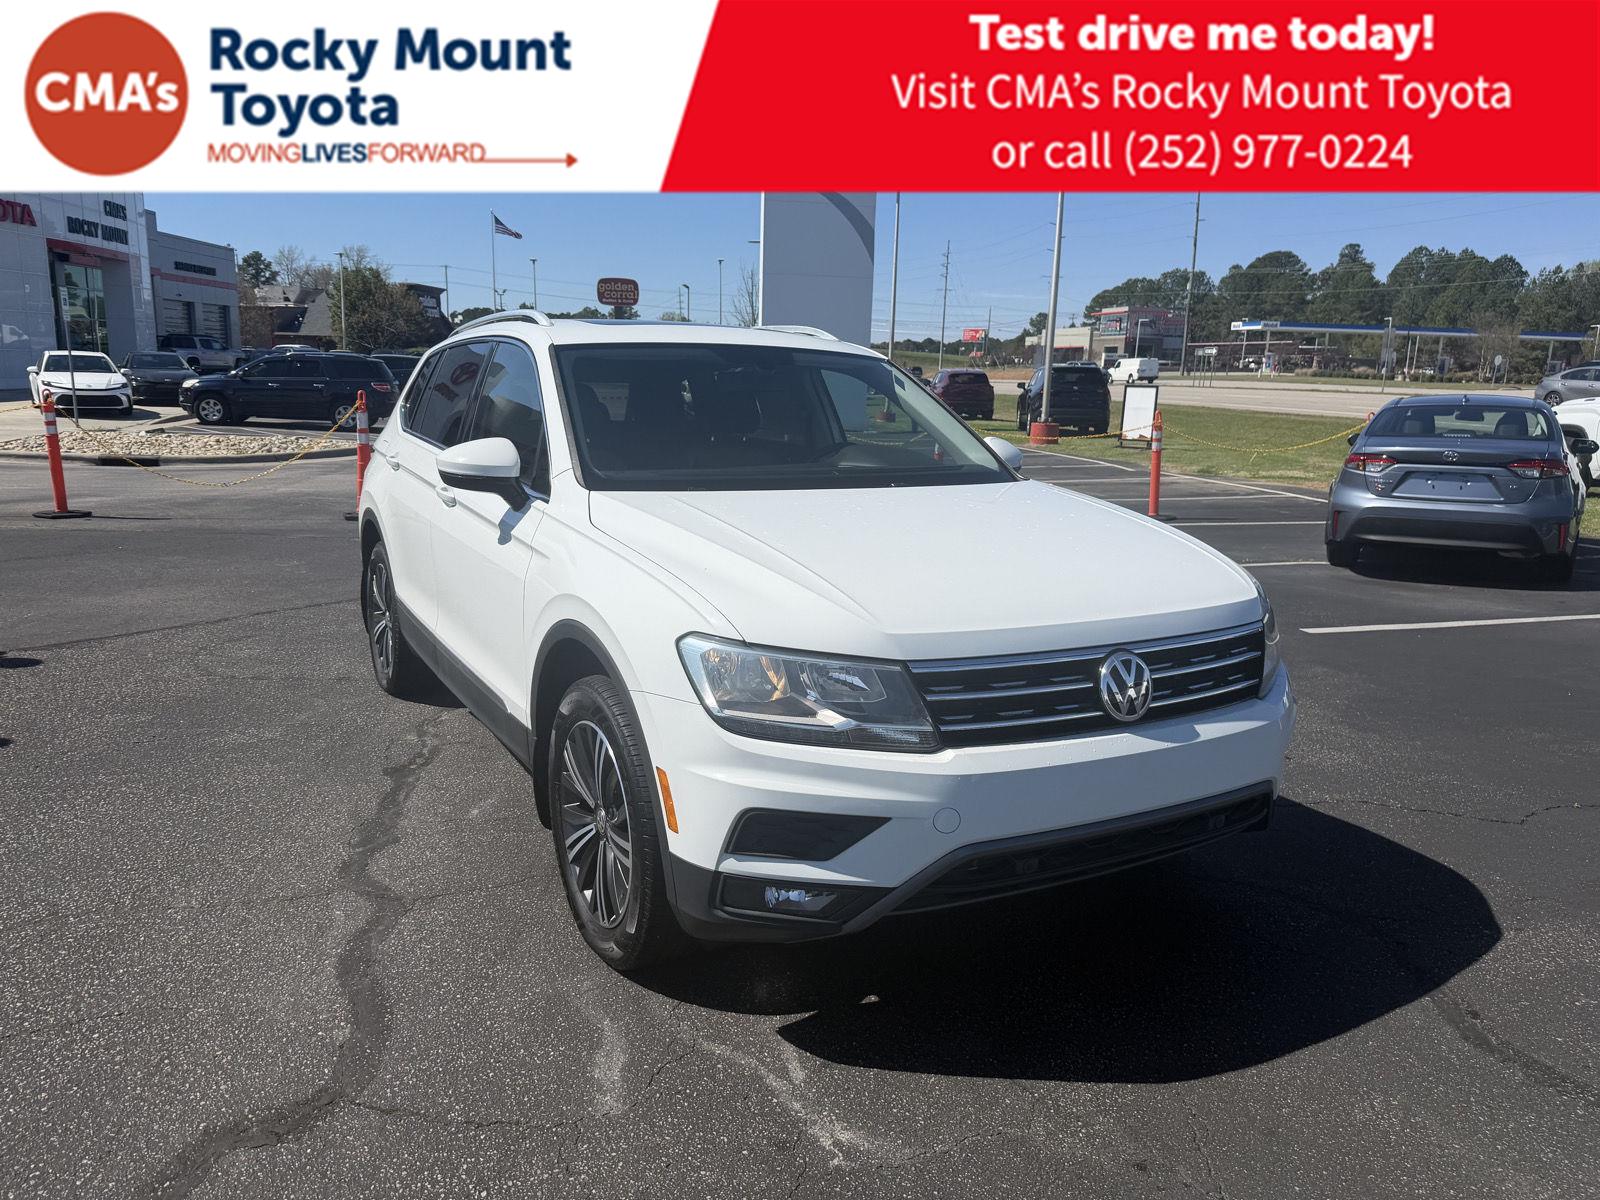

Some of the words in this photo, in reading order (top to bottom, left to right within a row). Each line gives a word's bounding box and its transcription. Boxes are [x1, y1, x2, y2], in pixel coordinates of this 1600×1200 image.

[66, 215, 99, 238] ROCKY
[599, 282, 635, 292] golden
[604, 290, 638, 299] corral
